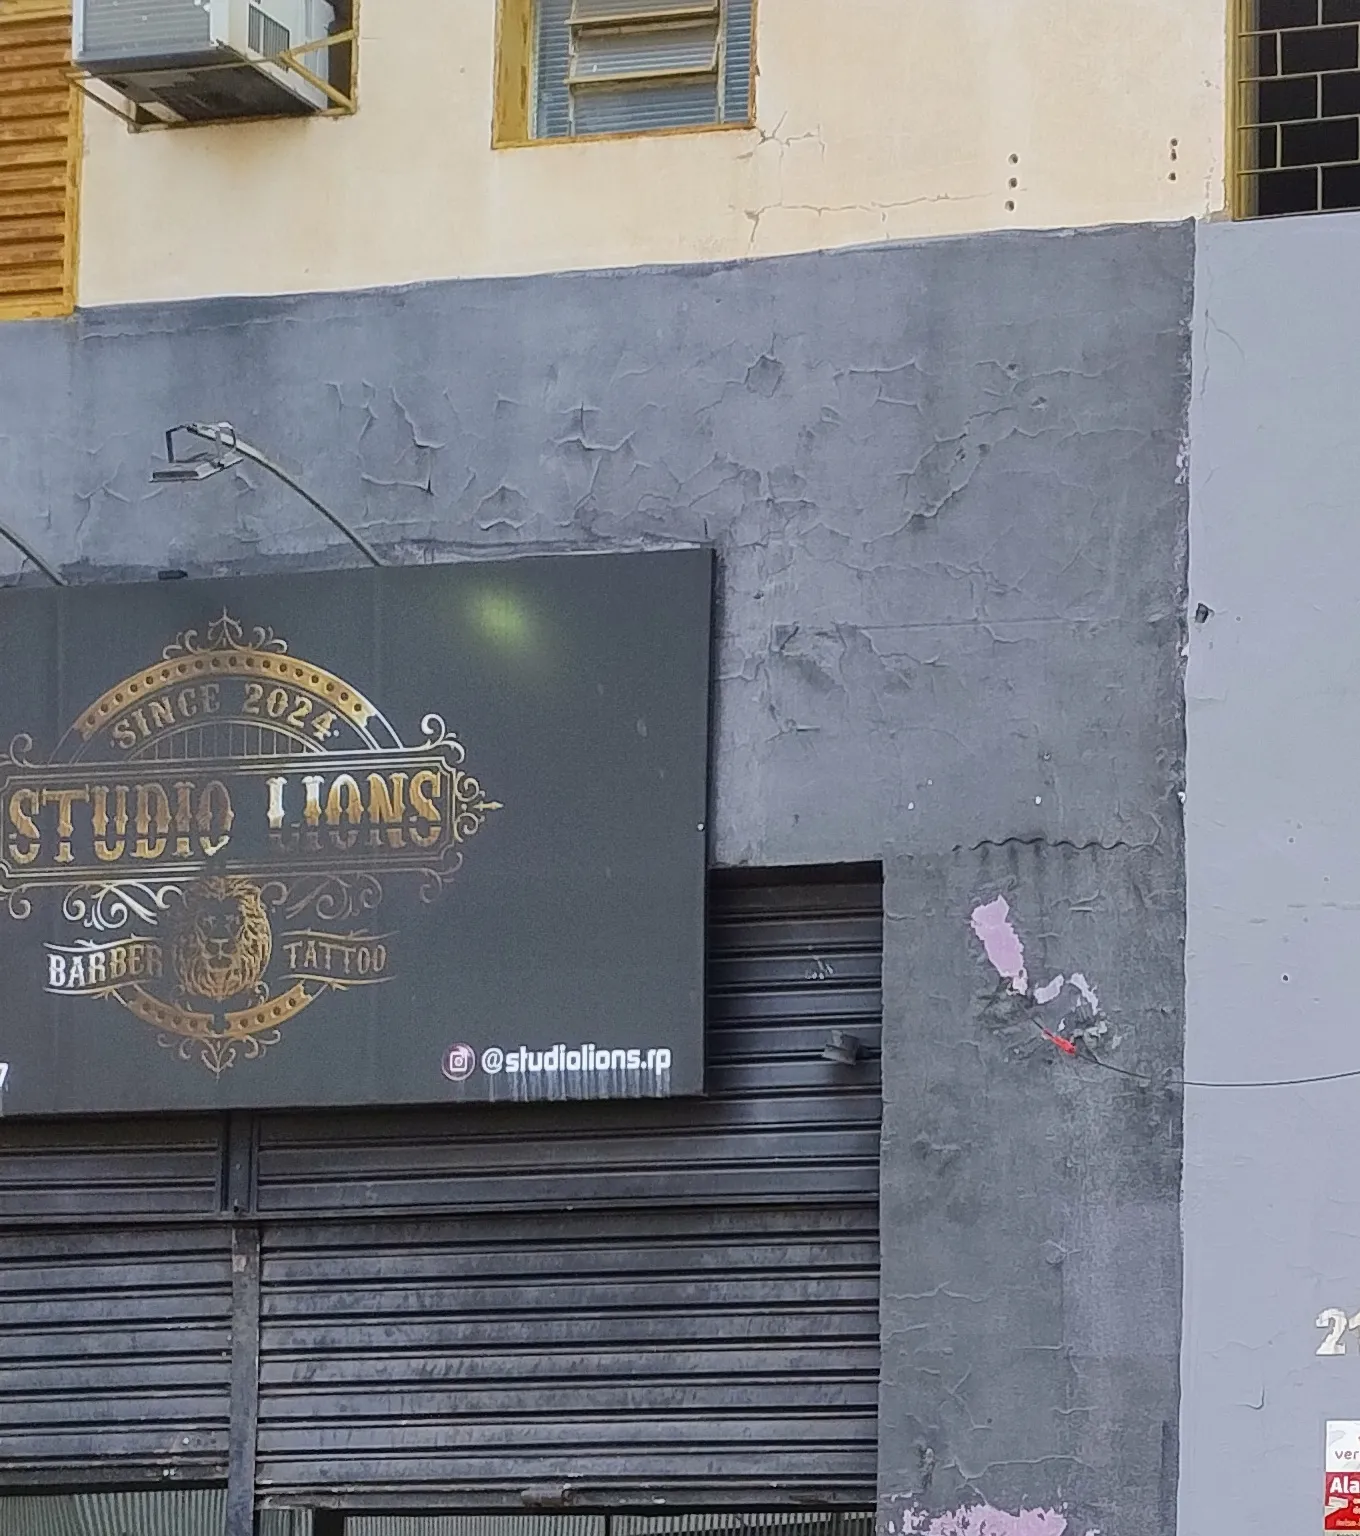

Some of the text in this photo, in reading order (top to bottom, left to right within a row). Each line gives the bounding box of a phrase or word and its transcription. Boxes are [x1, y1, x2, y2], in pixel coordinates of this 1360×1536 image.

[112, 683, 221, 749] SINCE
[8, 769, 442, 865] STUDIO LIONS
[47, 940, 388, 988] BARBER TATTOO
[481, 1043, 672, 1076] @studiolions.rp
